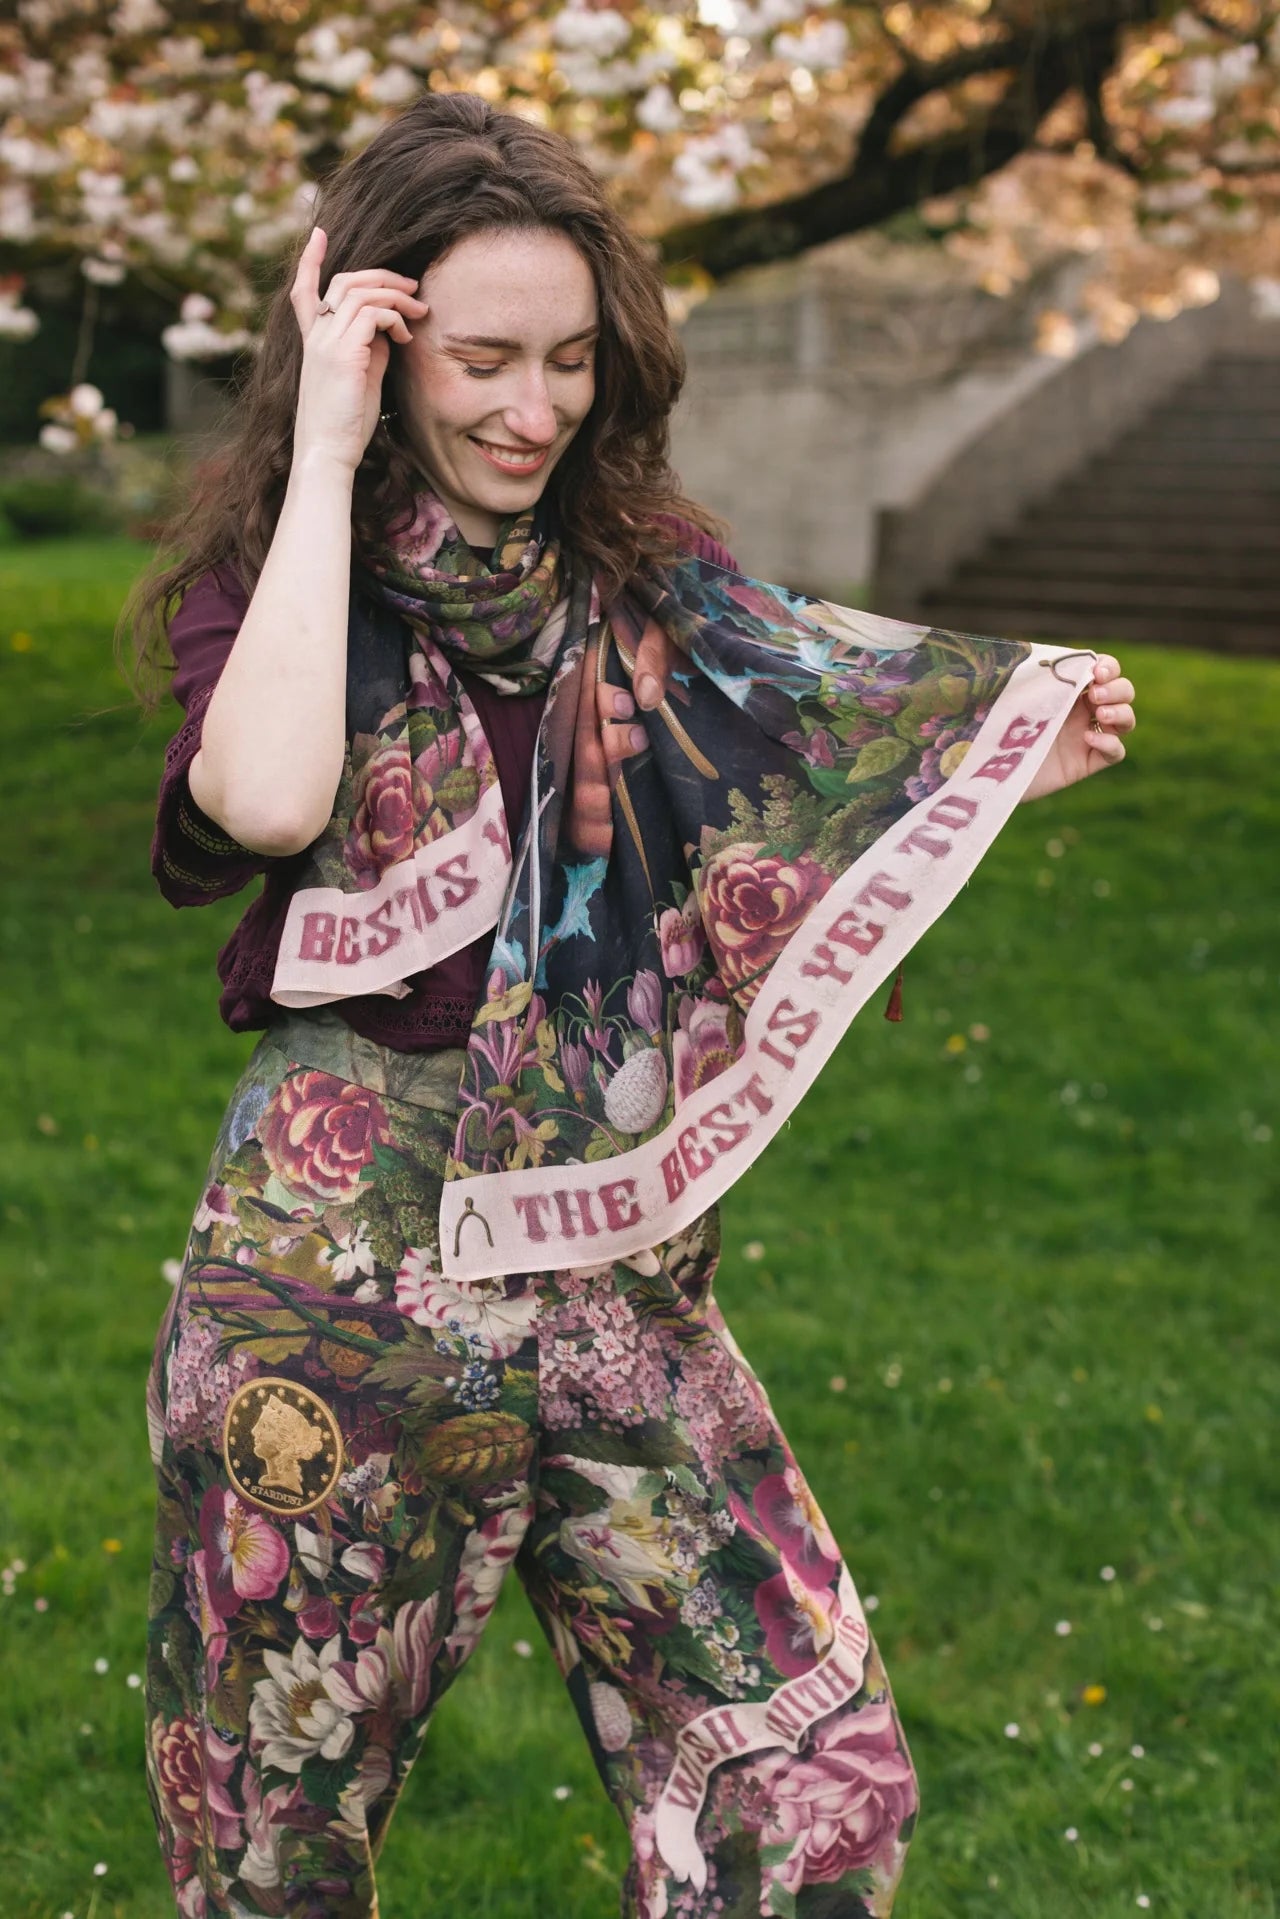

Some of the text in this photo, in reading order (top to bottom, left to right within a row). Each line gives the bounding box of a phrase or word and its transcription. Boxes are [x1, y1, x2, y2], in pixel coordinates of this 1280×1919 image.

[298, 887, 425, 965] BEST
[513, 713, 1050, 1244] THE BEST IS YET TO BE
[249, 1485, 304, 1507] STARDUST
[665, 1710, 748, 1812] WISH
[765, 1657, 856, 1743] WITH
